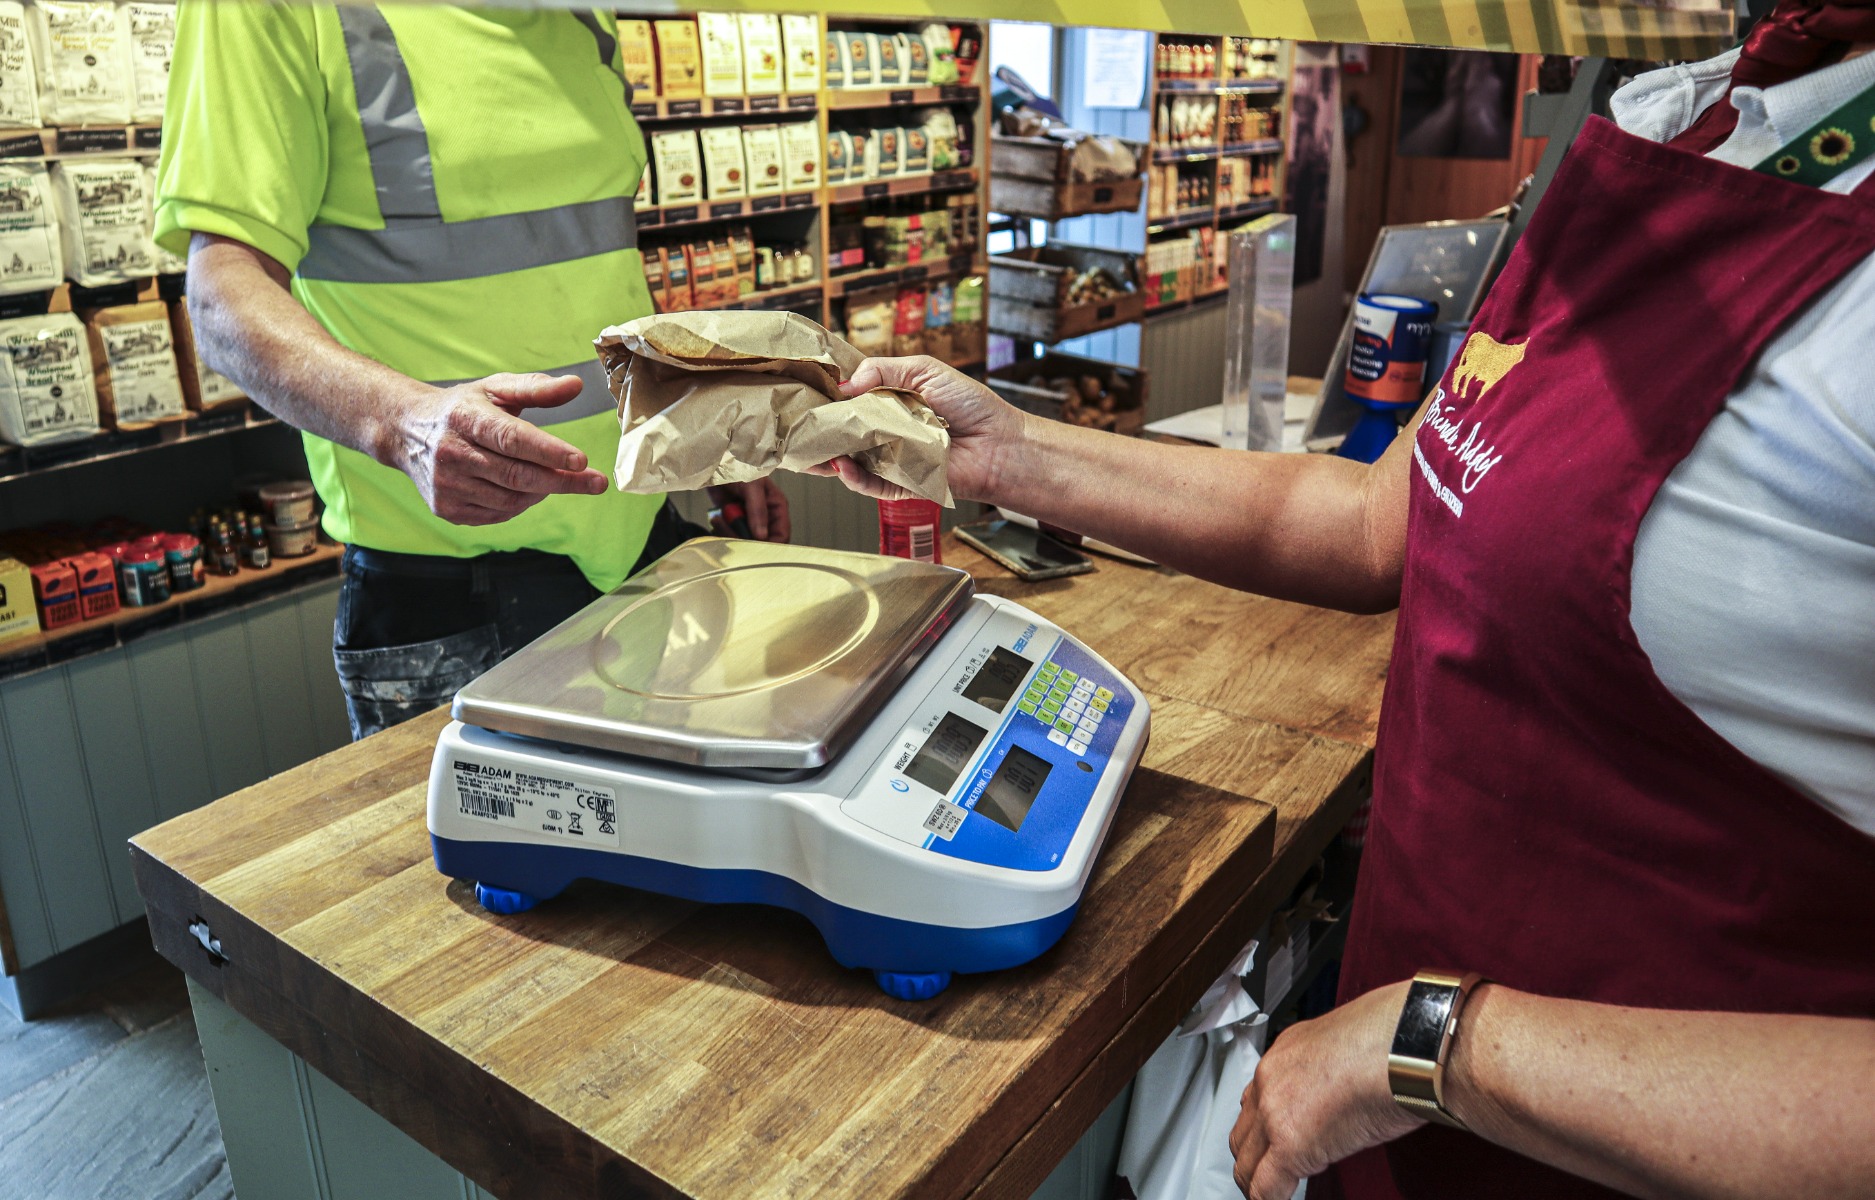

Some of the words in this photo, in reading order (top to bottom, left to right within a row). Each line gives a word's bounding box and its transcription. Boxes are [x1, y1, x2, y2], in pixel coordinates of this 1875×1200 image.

[894, 751, 911, 770] WEIGHT
[481, 766, 511, 779] ADAM
[577, 794, 595, 810] CE
